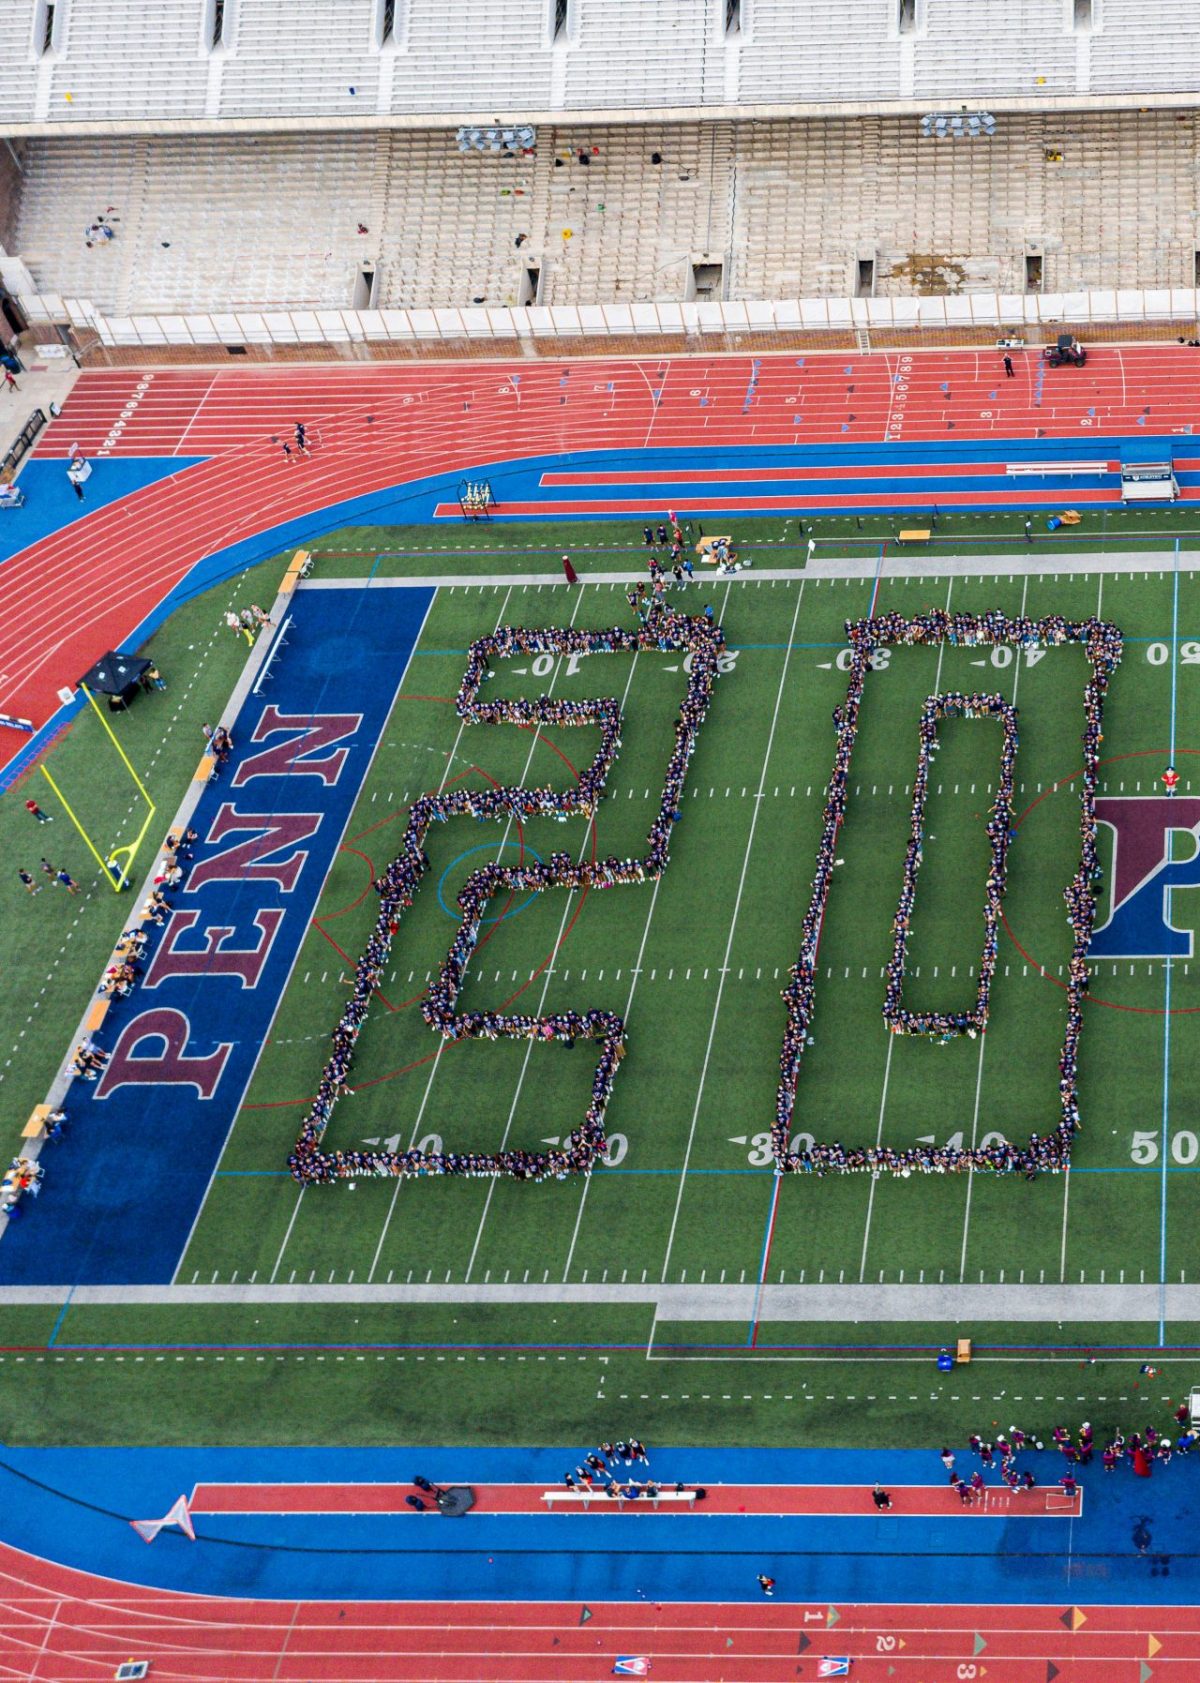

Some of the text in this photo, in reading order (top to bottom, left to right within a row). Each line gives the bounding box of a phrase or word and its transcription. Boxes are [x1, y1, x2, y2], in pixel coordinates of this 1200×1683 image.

[531, 653, 585, 677] 10
[990, 645, 1046, 668] 40
[92, 704, 364, 1100] PENN
[1130, 1131, 1199, 1164] 50
[803, 1611, 824, 1623] 1
[876, 1635, 896, 1652] 2
[957, 1663, 977, 1680] 3
